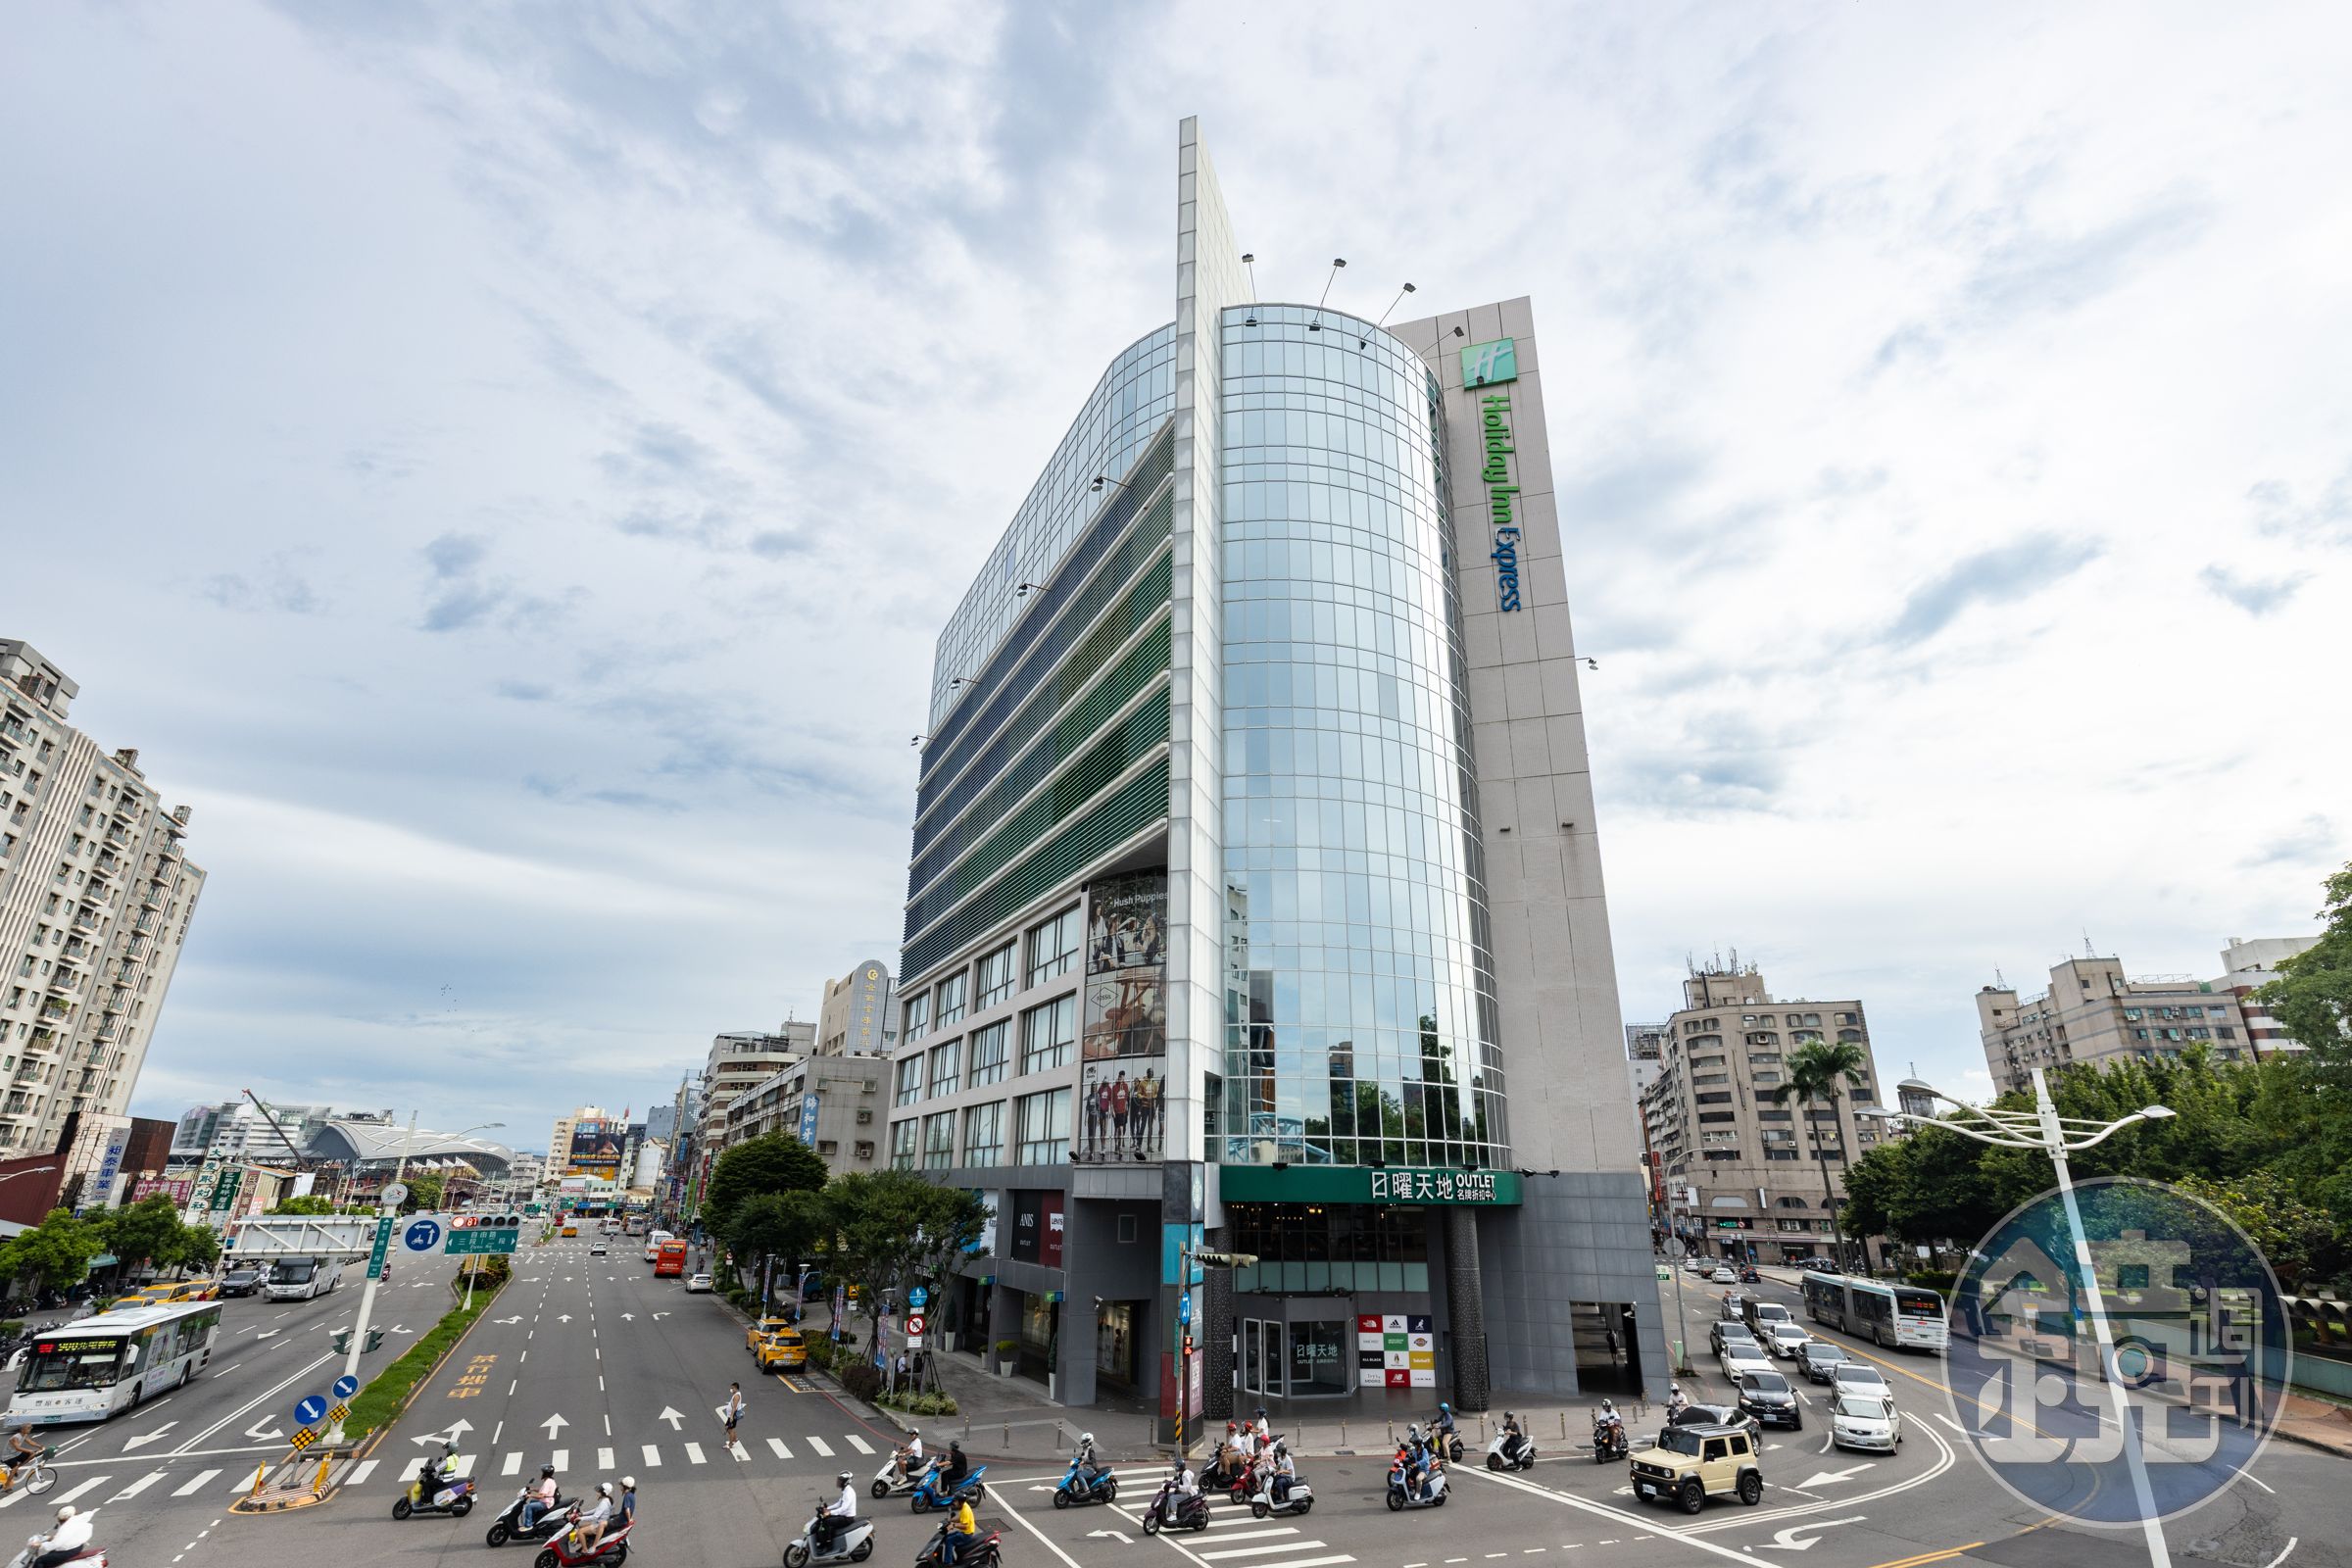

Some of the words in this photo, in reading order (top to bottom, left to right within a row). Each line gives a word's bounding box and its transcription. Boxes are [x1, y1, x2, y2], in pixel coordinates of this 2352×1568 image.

[1481, 394, 1515, 482] Holiday
[1491, 486, 1521, 523] Inn
[1491, 526, 1522, 612] Express
[1113, 896, 1134, 907] Hush
[1135, 891, 1169, 904] Puppies
[1372, 1172, 1452, 1200] 日曜天地
[1456, 1174, 1495, 1188] OUTLET
[1457, 1189, 1496, 1200] 名牌折扣中心
[466, 1217, 477, 1226] 87
[470, 1231, 497, 1241] 自由路
[1297, 1344, 1339, 1358] 日曜天地
